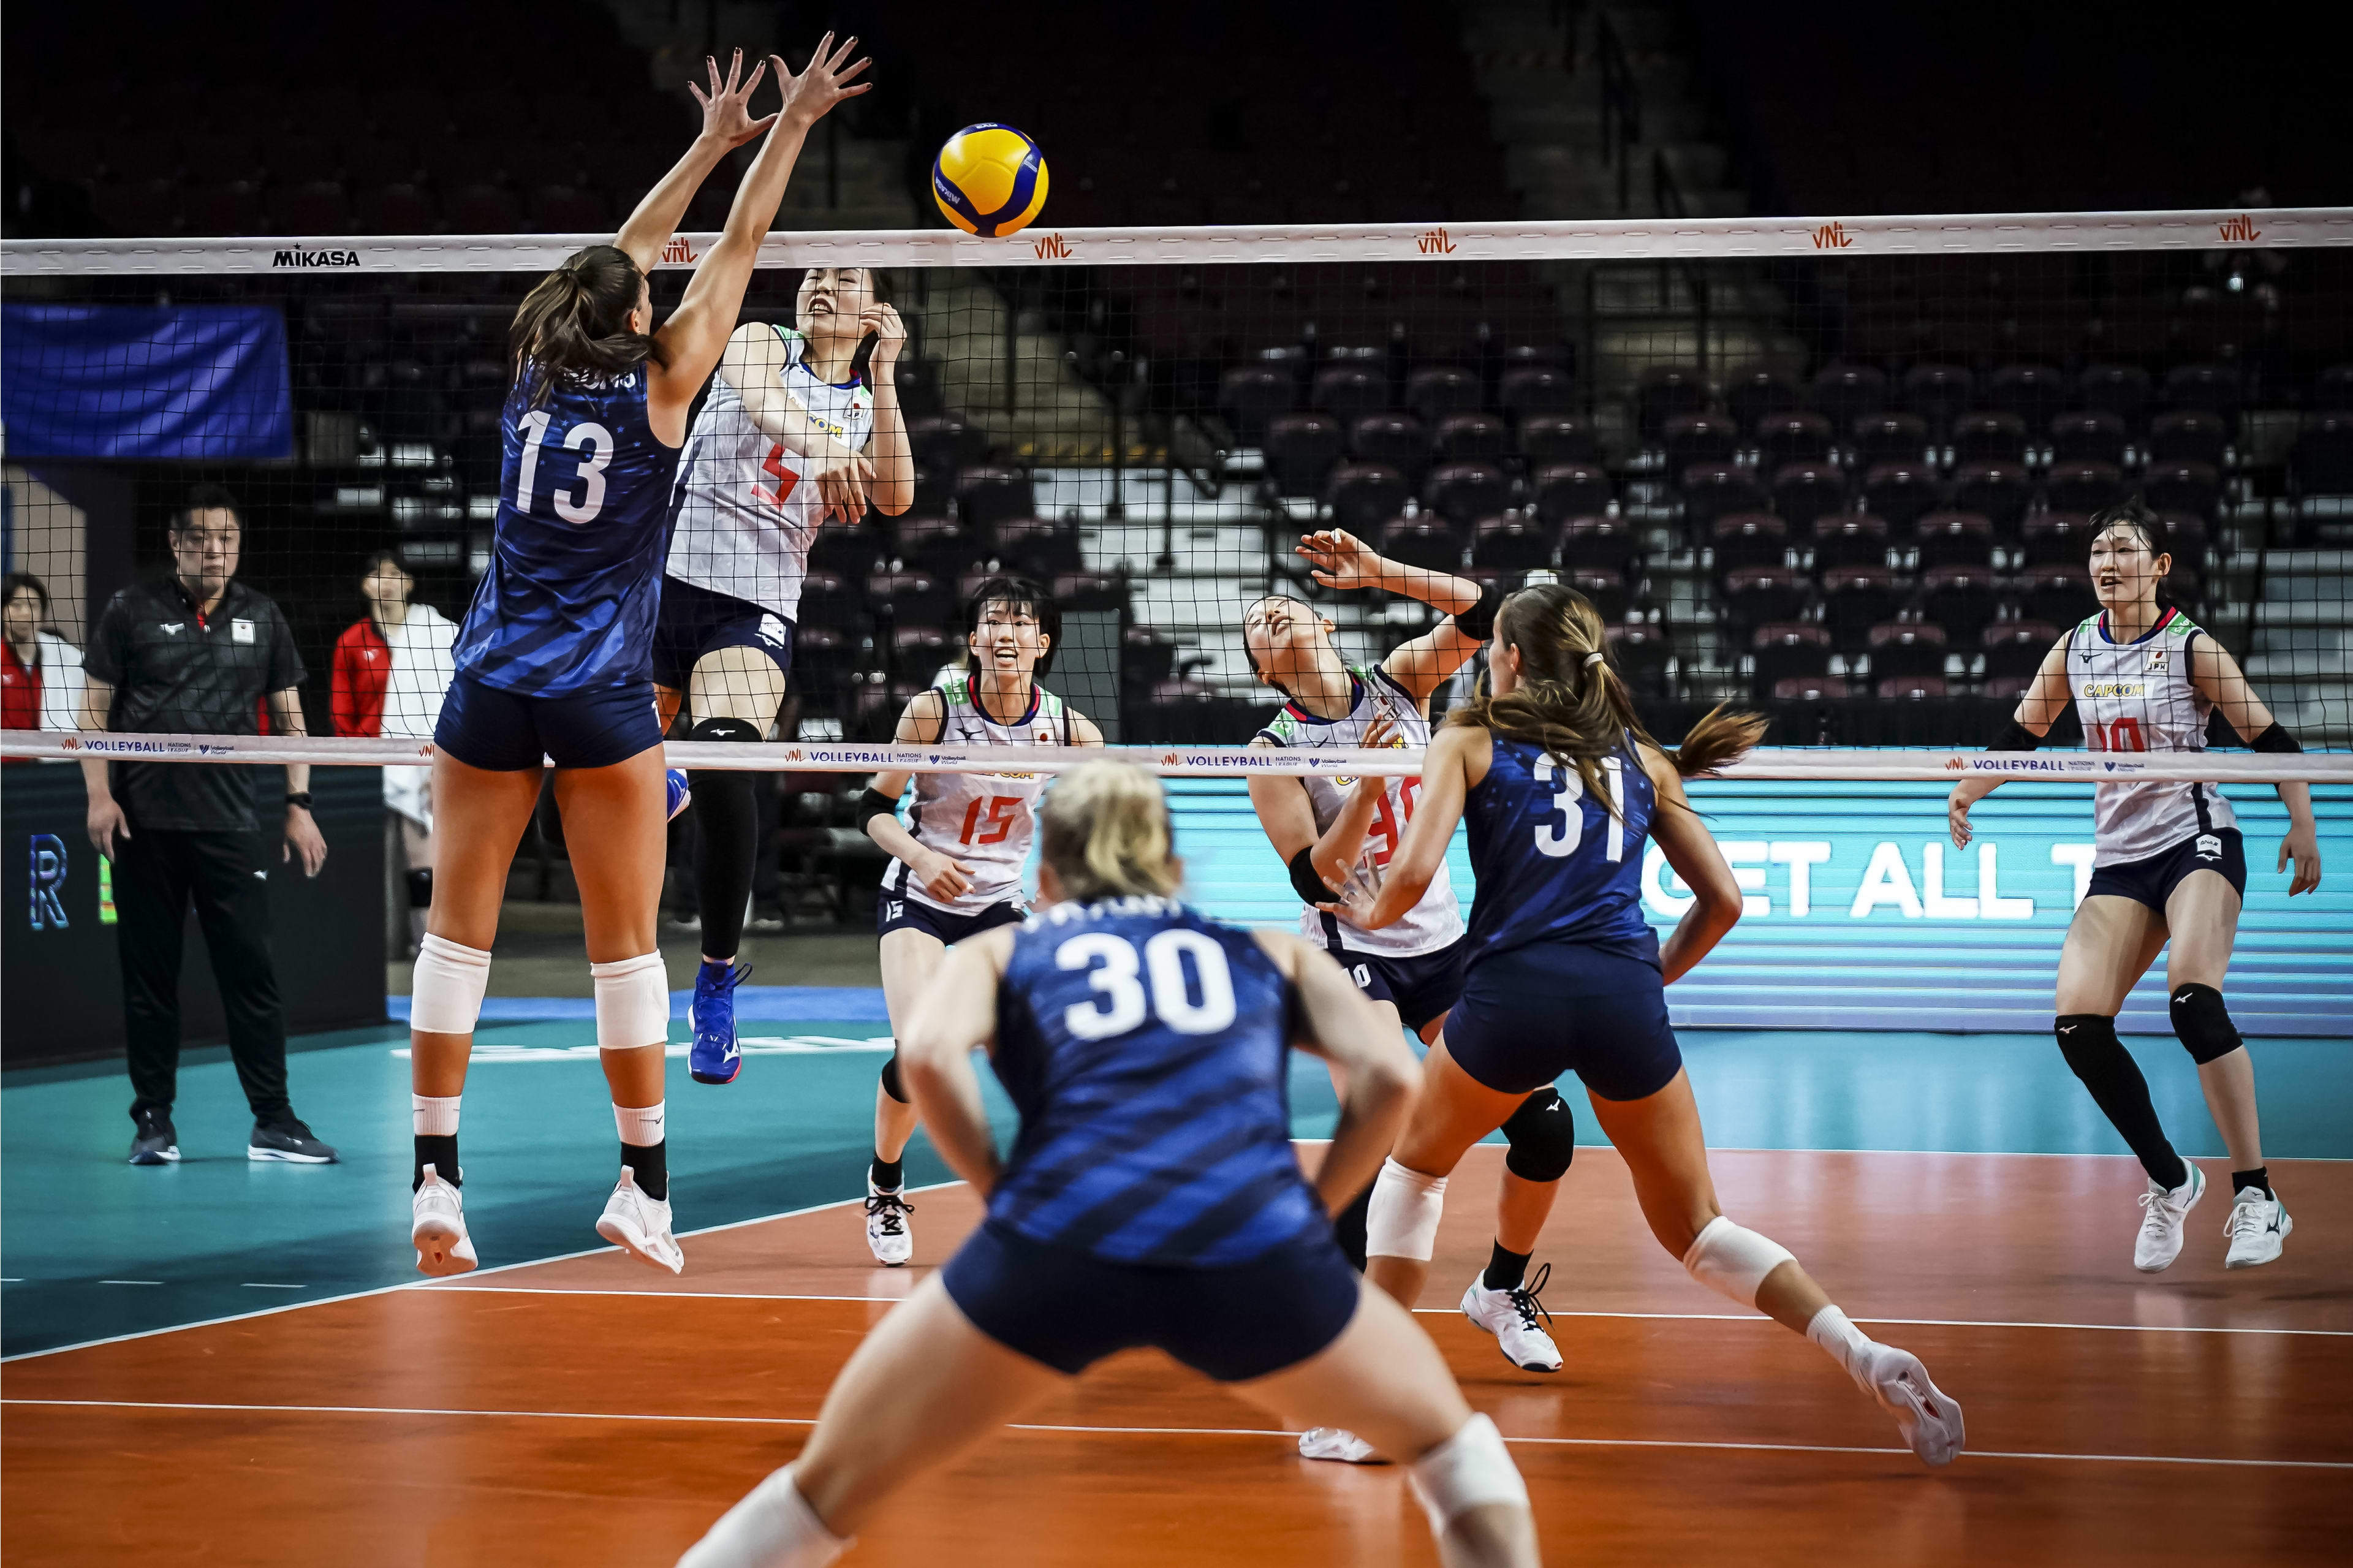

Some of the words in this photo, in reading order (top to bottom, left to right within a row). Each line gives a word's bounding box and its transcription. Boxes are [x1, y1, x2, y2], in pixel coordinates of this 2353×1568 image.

[1418, 227, 1457, 253] VNL
[1813, 221, 1852, 248] VNL
[2219, 214, 2261, 241] VNL
[273, 247, 360, 267] MIKASA
[662, 237, 698, 263] VNL
[1034, 232, 1072, 259] VNL
[517, 410, 613, 523] 13
[751, 443, 800, 512] 5
[2084, 684, 2145, 697] CAPCOM
[62, 737, 82, 750] VNL
[85, 740, 165, 752] VOLLEYBALL
[785, 748, 806, 762] VNL
[810, 752, 893, 763] VOLLEYBALL
[1161, 752, 1182, 766] VNL
[1186, 756, 1272, 767] VOLLEYBALL
[1945, 757, 1968, 770] VNL
[1973, 760, 2064, 771] VOLLEYBALL
[958, 795, 1025, 846] 15
[1534, 752, 1624, 863] 31
[1640, 841, 1832, 918] GET
[1849, 841, 2035, 919] ALL
[885, 900, 903, 922] 15
[1055, 928, 1237, 1040] 30
[1343, 963, 1371, 988] 0
